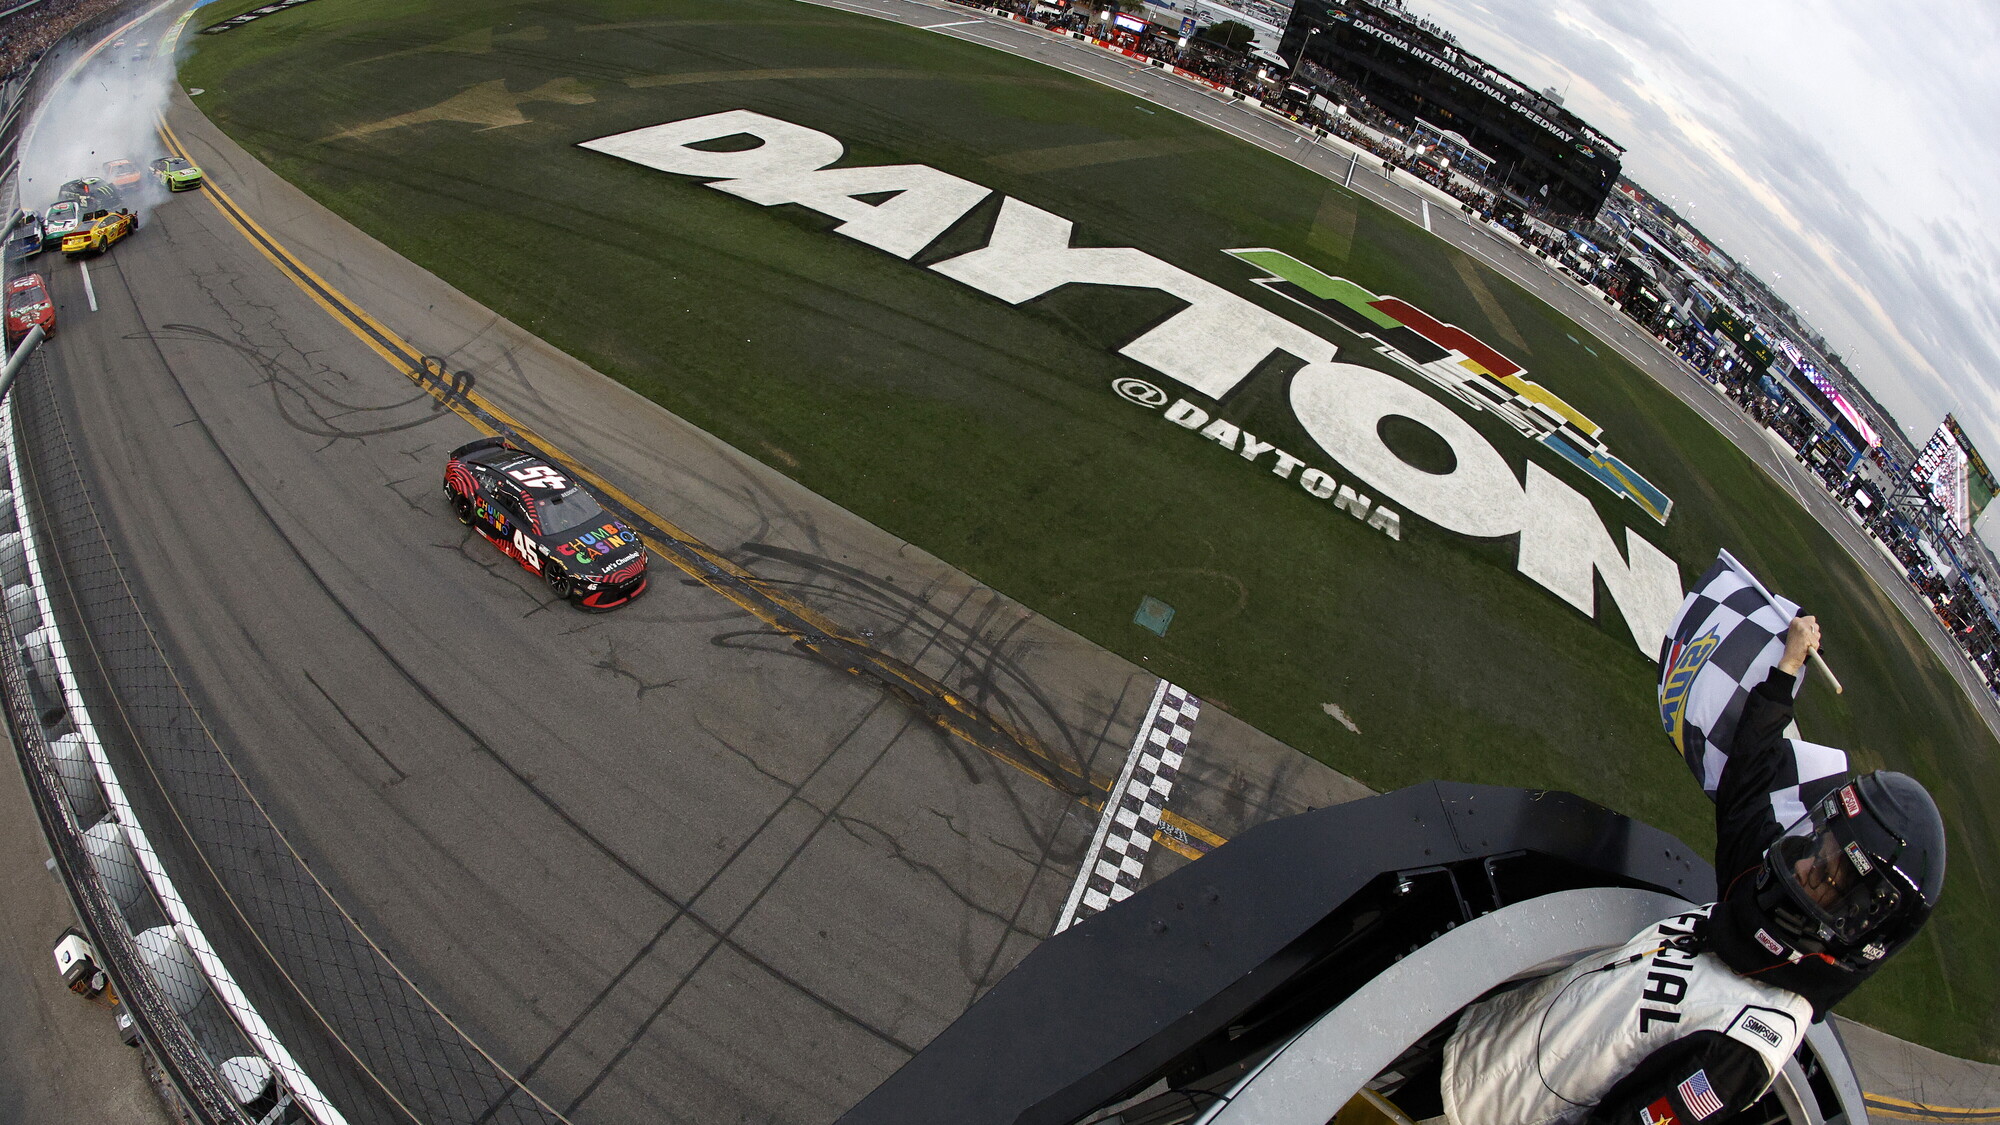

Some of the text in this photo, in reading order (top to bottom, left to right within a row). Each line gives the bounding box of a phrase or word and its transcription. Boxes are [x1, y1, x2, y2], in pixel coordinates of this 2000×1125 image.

[1352, 19, 1574, 142] DAYTONA INTERNATIONAL SPEEDWAY
[577, 108, 1686, 664] DAYTON
[507, 465, 567, 490] 45
[476, 495, 510, 529] CHUMBA
[476, 507, 509, 536] CASINO
[513, 529, 540, 570] 45
[556, 520, 625, 556] CHUMBA
[576, 531, 635, 564] CASINO
[601, 562, 617, 574] Let's
[1843, 786, 1858, 813] SIMPSON
[1757, 932, 1780, 953] SIMPSON
[1862, 943, 1886, 959] BUSCH
[1640, 904, 1713, 1033] FICIAL
[1745, 1019, 1779, 1044] SIMPSON
